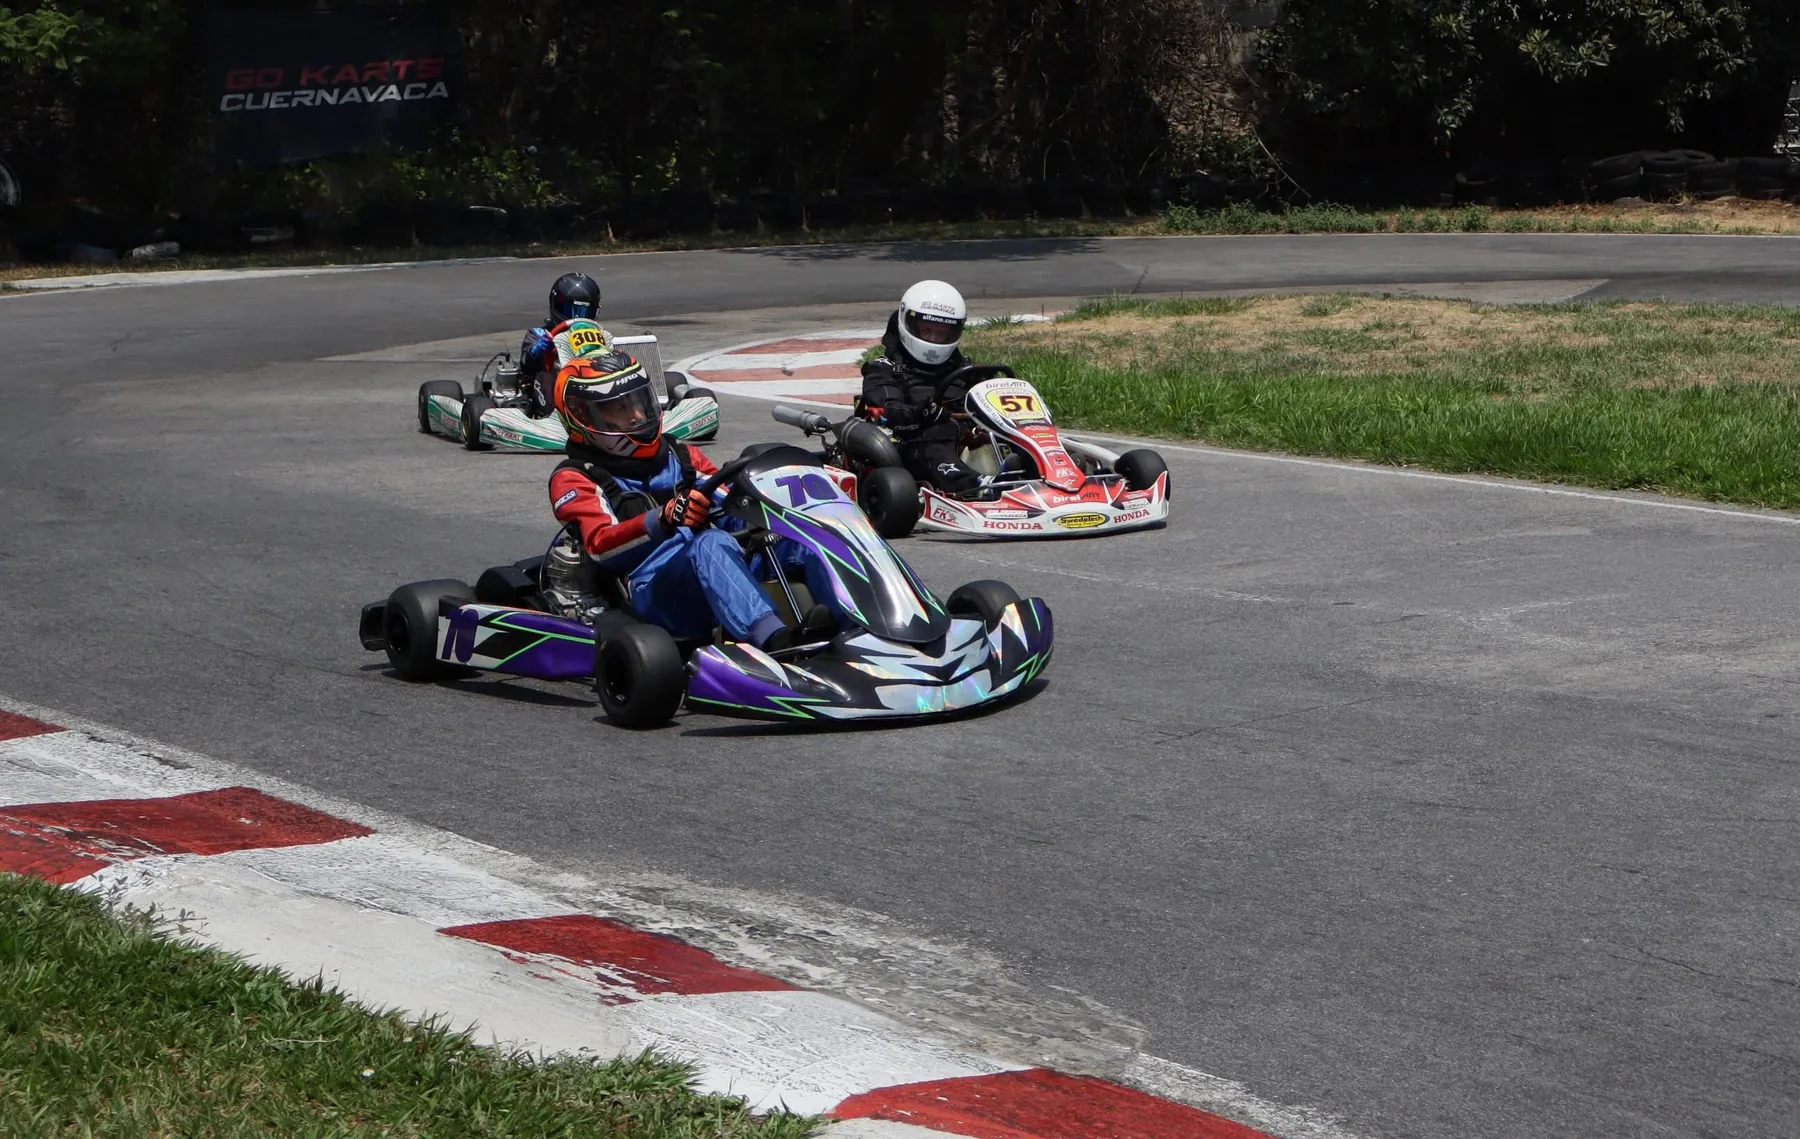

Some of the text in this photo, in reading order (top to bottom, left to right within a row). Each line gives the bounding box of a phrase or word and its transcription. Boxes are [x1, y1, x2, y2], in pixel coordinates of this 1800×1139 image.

[225, 57, 444, 89] GO KARTS
[220, 82, 449, 111] CUERNAVACA
[922, 314, 957, 324] alfano.com
[572, 330, 606, 347] 308
[999, 395, 1034, 412] 57
[775, 473, 839, 508] 70
[672, 494, 687, 522] FOX
[1113, 508, 1150, 523] HONDA
[983, 520, 1043, 530] HONDA
